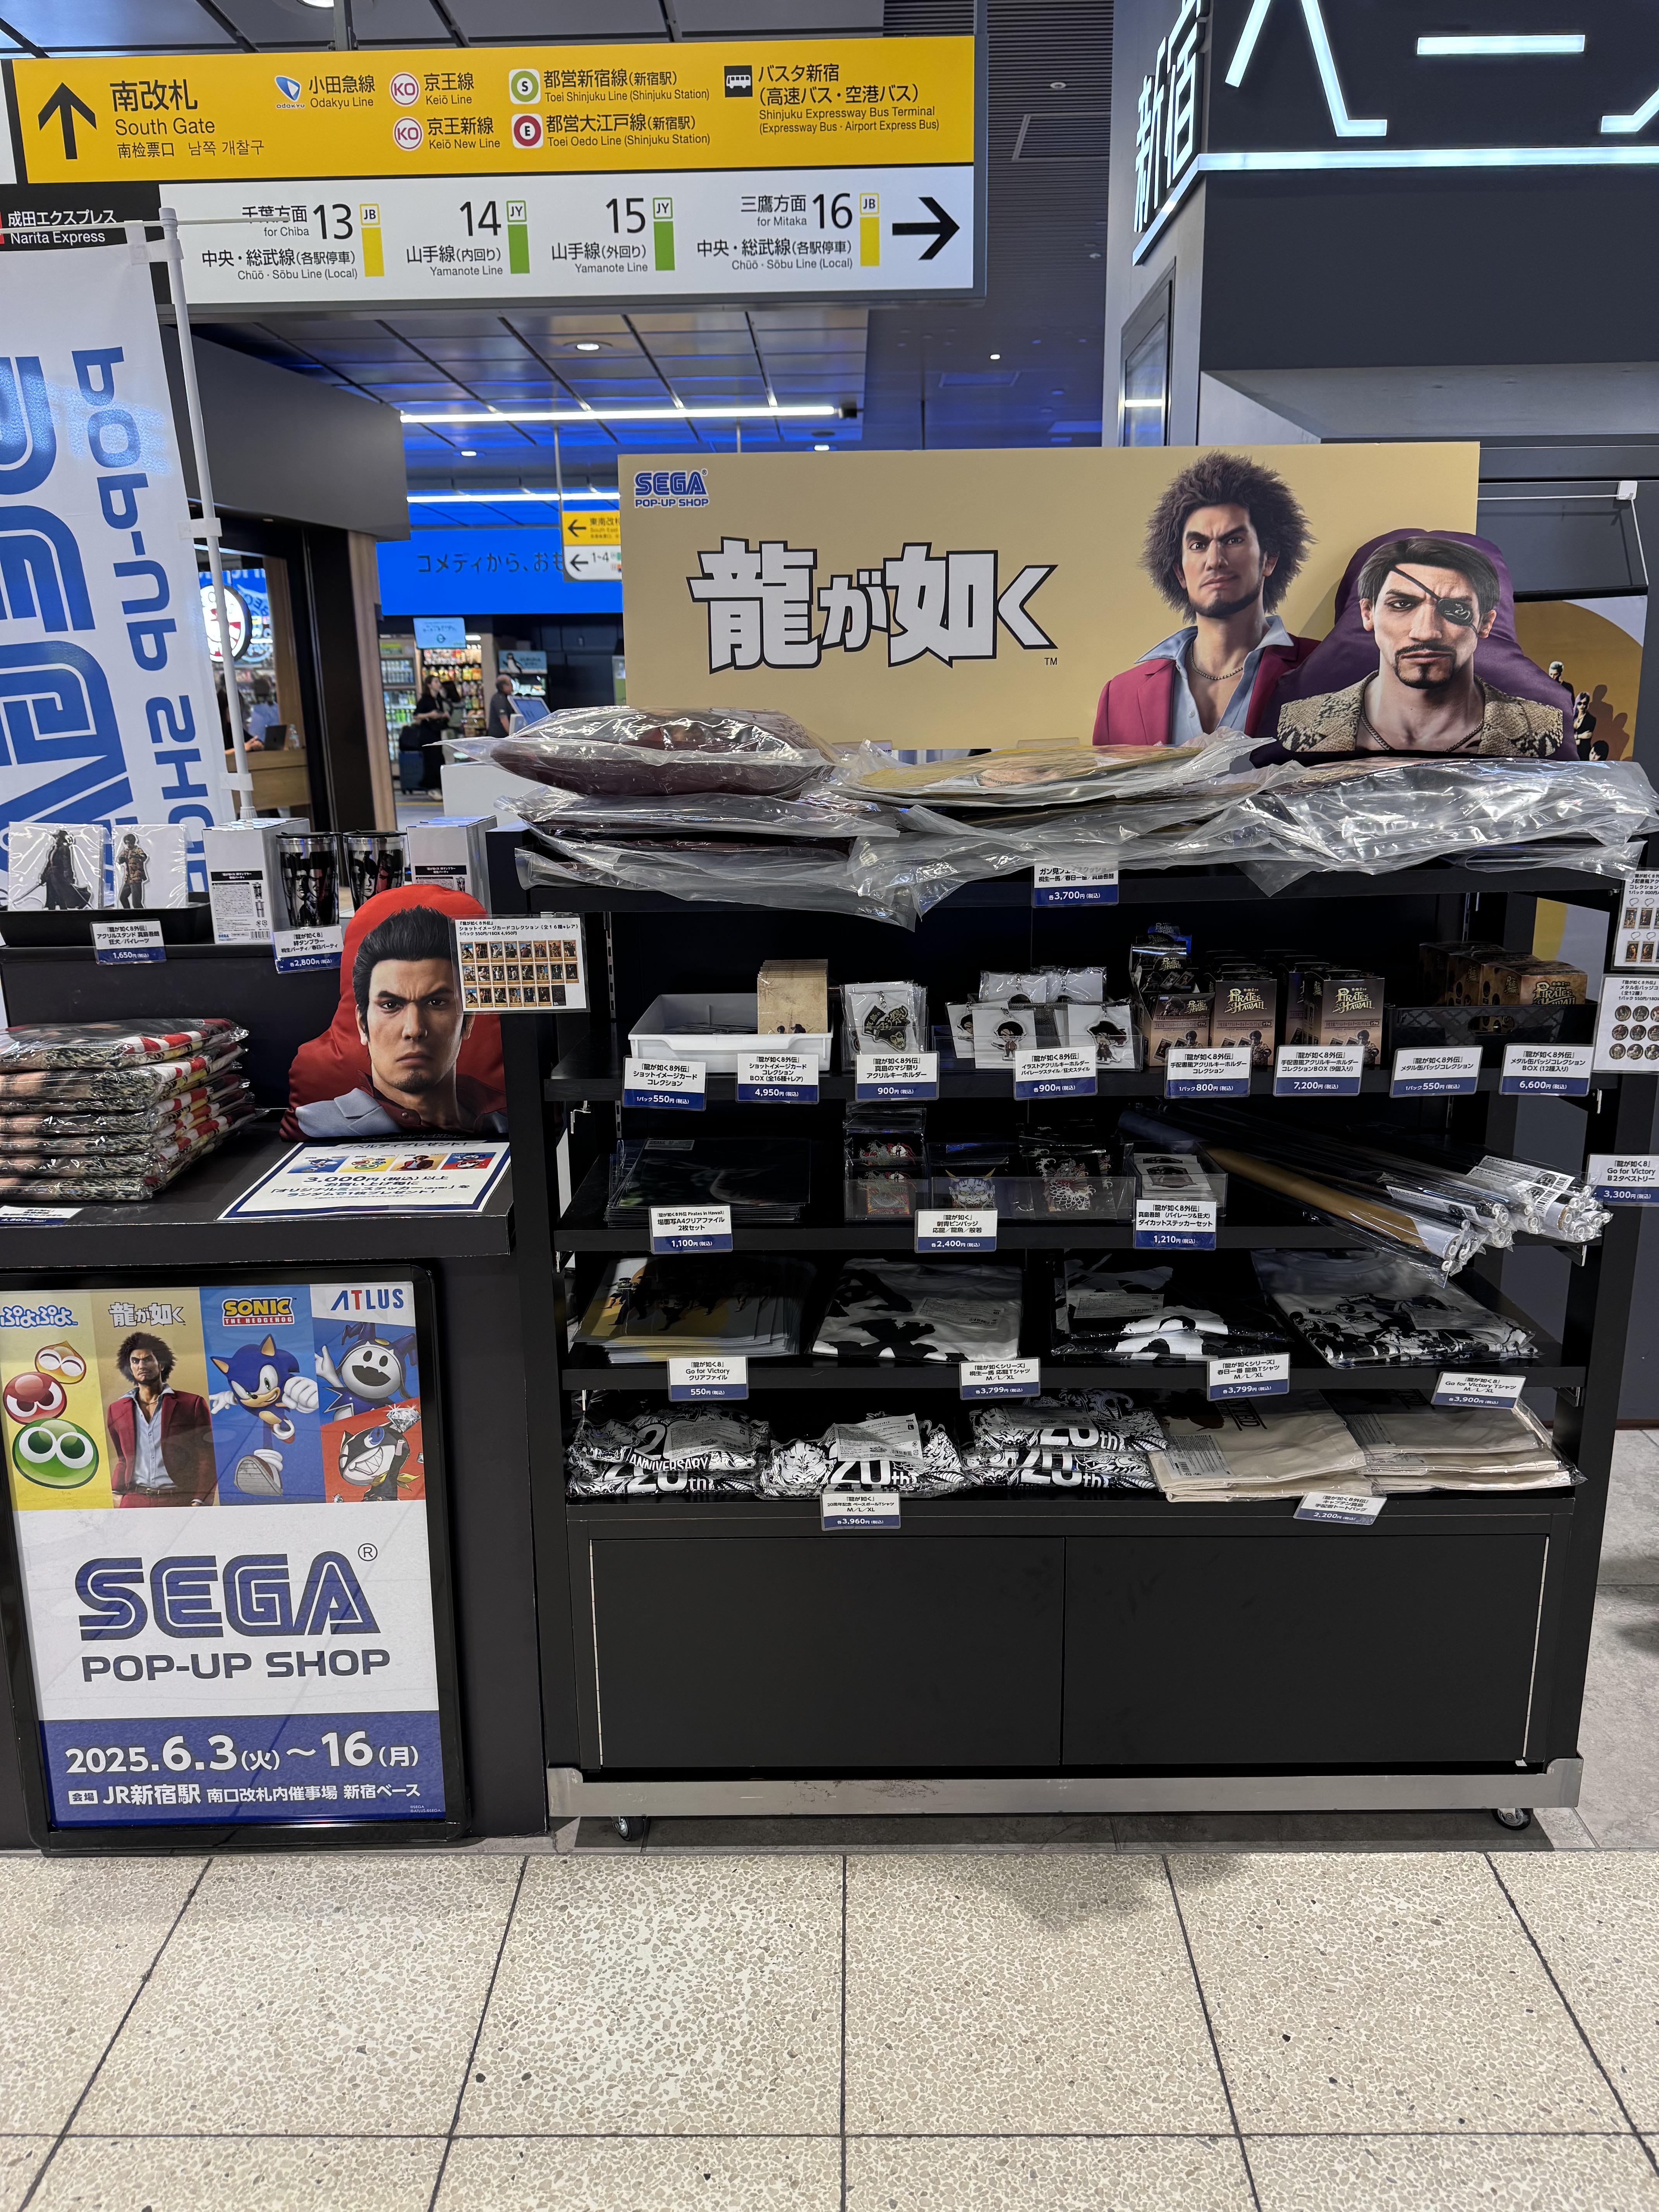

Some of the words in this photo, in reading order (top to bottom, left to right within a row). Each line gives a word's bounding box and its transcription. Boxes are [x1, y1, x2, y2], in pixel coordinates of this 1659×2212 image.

[758, 63, 839, 82] バスタ新宿
[309, 75, 375, 94] 小田急線
[394, 82, 416, 96] KO
[424, 72, 474, 91] 京王線
[521, 81, 528, 92] S
[110, 79, 198, 112] 南改札
[310, 98, 349, 109] Odakyu
[353, 97, 374, 107] Line
[426, 94, 448, 105] Keiō
[451, 94, 472, 105] Line
[546, 92, 564, 102] Toei
[567, 92, 606, 103] Shinjuku
[608, 91, 627, 101] Line
[630, 90, 671, 102] (Shinjuku
[674, 89, 709, 101] Station)
[759, 109, 802, 121] Shinjuku
[805, 108, 866, 119] Expressway
[869, 107, 889, 117] Bus
[892, 106, 935, 117] Terminal
[115, 118, 167, 136] South
[173, 117, 215, 134] Gate
[397, 127, 419, 141] KO
[427, 117, 494, 135] 京王新線
[525, 126, 530, 136] E
[759, 122, 817, 135] (Expressway
[820, 122, 837, 132] Bus
[845, 120, 877, 132] Airport
[879, 120, 916, 131] Express
[919, 119, 939, 130] Bus)
[188, 141, 217, 157] 남쪽
[222, 140, 265, 156] 개찰구
[429, 139, 451, 149] Keiō
[454, 139, 476, 149] New
[479, 139, 500, 148] Line
[548, 137, 567, 147] Toei
[571, 136, 598, 146] Oedo
[601, 136, 621, 146] Line
[624, 135, 669, 147] (Shinjuku
[672, 134, 710, 146] Station)
[117, 142, 175, 159] 南检票口
[656, 202, 669, 213] JY
[741, 195, 807, 213] 三鷹方面
[812, 193, 853, 230] 16
[863, 198, 875, 209] JB
[8, 209, 117, 227] 成田エクスプレス
[242, 205, 307, 223] 千葉方面
[364, 210, 376, 221] JB
[460, 201, 501, 237] 14
[510, 207, 522, 217] JY
[606, 198, 646, 233] 15
[313, 204, 353, 240] 13
[757, 217, 771, 227] for
[773, 216, 807, 227] Mitaka
[10, 231, 50, 245] Narita
[53, 230, 106, 246] Express
[264, 227, 279, 236] for
[281, 226, 309, 236] Chiba
[429, 266, 480, 276] Yamanote
[482, 266, 503, 275] Line
[575, 263, 624, 273] Yamanote
[627, 262, 648, 272] Line
[732, 259, 758, 270] Chūō
[766, 259, 792, 269] Sōbu
[793, 258, 817, 269] Line
[819, 258, 853, 270] (Local)
[237, 270, 264, 280] Chūō
[273, 269, 299, 279] Sōbu
[301, 269, 323, 278] Line
[325, 268, 358, 279] (Local)
[635, 471, 707, 496] SEGA
[678, 498, 708, 507] SHOP
[686, 536, 1060, 674] 龍が如く
[1022, 1061, 1089, 1069] イラストアクリルキーホルダー
[1400, 1063, 1474, 1072] メタル缶バッジコレクション
[633, 1071, 697, 1080] ショットイメージカード
[330, 1288, 404, 1311] ATLUS
[0, 1304, 74, 1328] ぷよぷよ
[108, 1302, 184, 1328] 龍が如く
[223, 1298, 292, 1318] SONIC
[245, 1316, 294, 1324] HEDGEHOG
[75, 1550, 381, 1641] SEGA
[81, 1652, 252, 1682] POP-UP
[265, 1649, 390, 1678] SHOP
[71, 1792, 96, 1803] 会場
[102, 1784, 201, 1806] JR新宿駅
[207, 1784, 338, 1804] 南口改札内催事場
[343, 1783, 421, 1800] 新宿ベース
